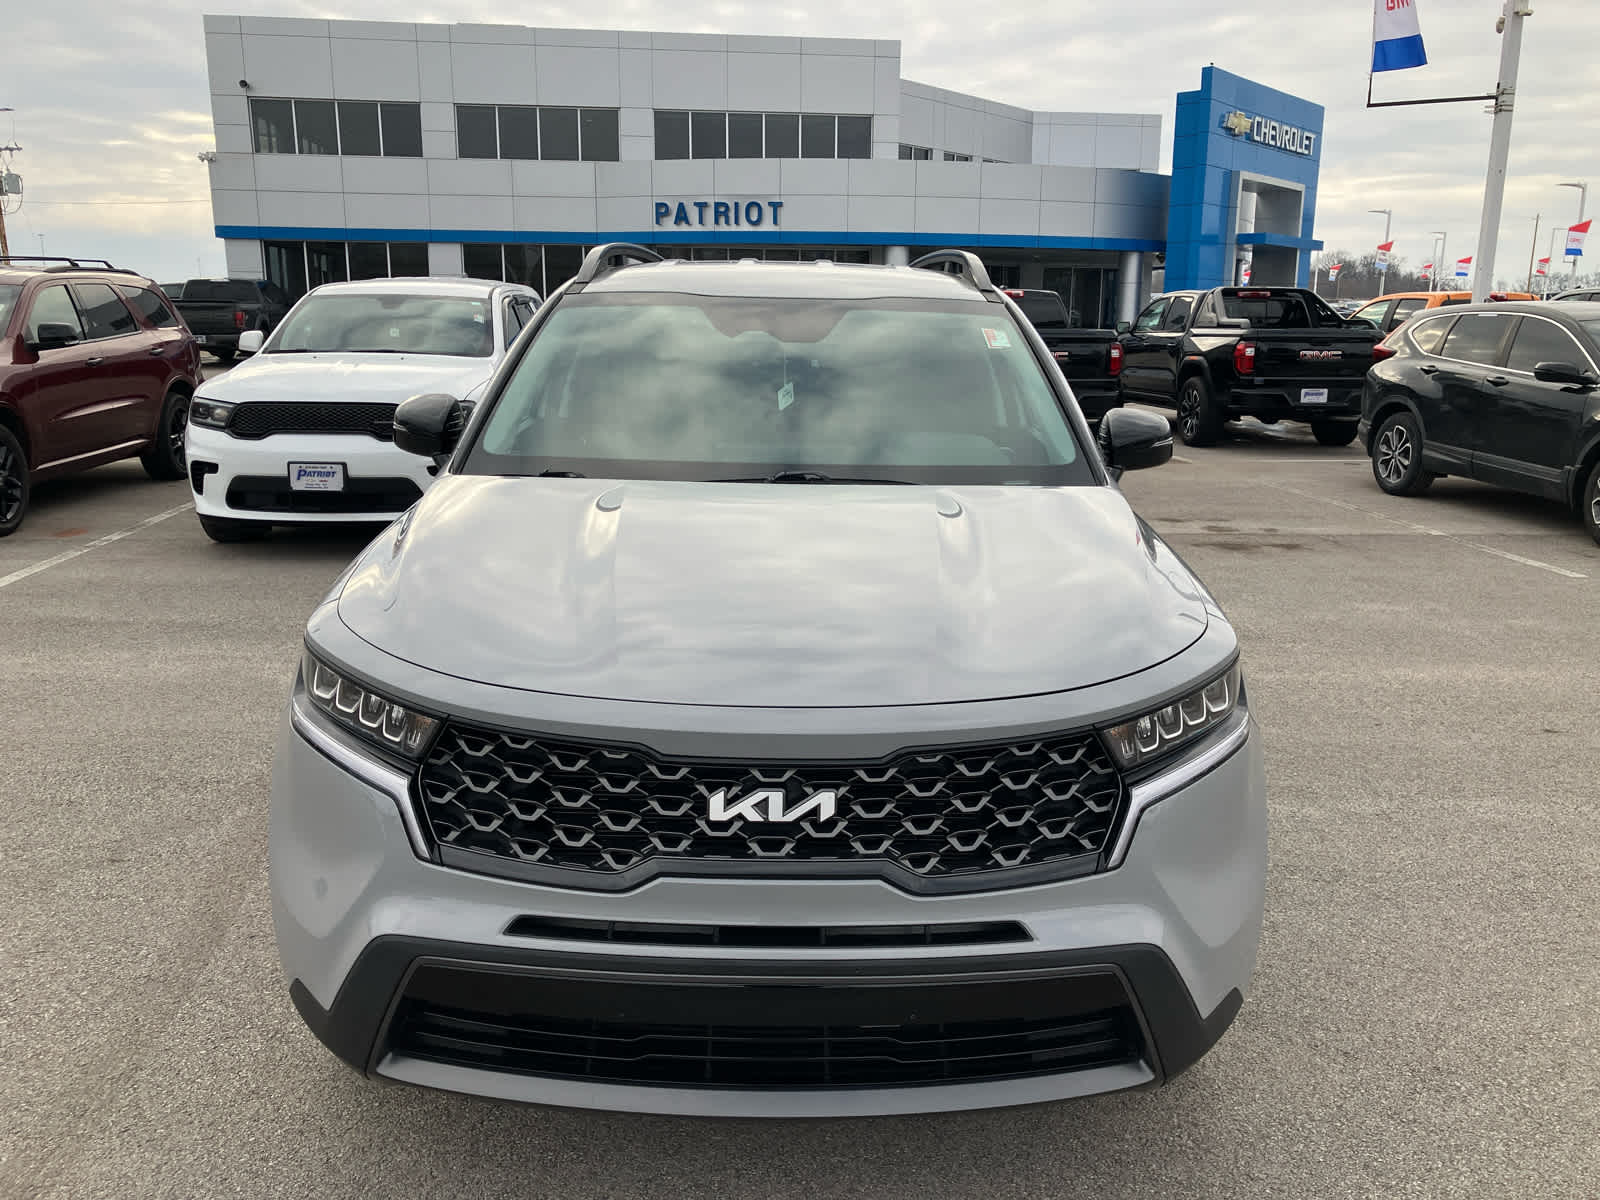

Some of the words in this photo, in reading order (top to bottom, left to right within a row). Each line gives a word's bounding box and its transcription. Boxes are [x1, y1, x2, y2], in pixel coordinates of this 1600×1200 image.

[1253, 116, 1316, 155] CHEVROLET
[655, 201, 783, 226] PATRIOT
[707, 787, 837, 823] KIA
